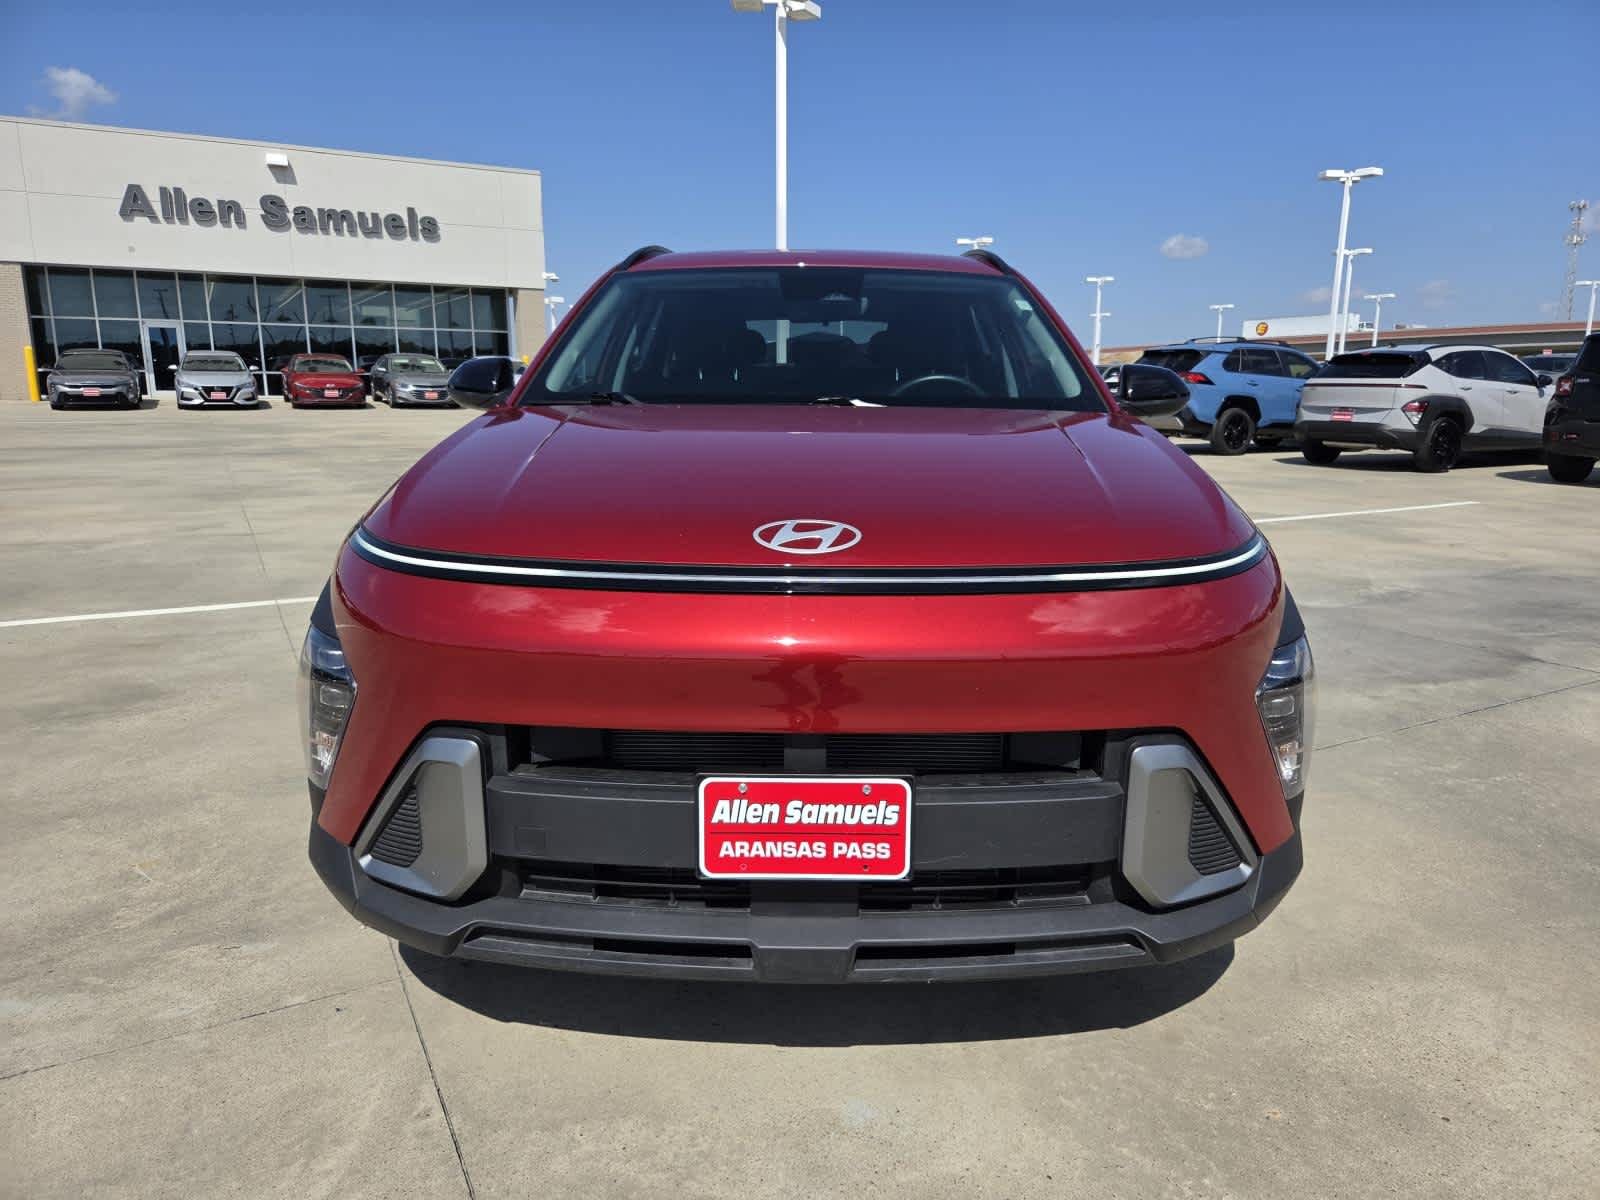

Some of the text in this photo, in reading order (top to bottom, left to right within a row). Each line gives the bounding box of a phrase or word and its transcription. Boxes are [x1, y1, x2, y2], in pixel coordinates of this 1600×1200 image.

[119, 184, 441, 243] Allen Samuels
[711, 798, 900, 825] Allen Samuels
[719, 840, 891, 859] ARANSAS PASS
